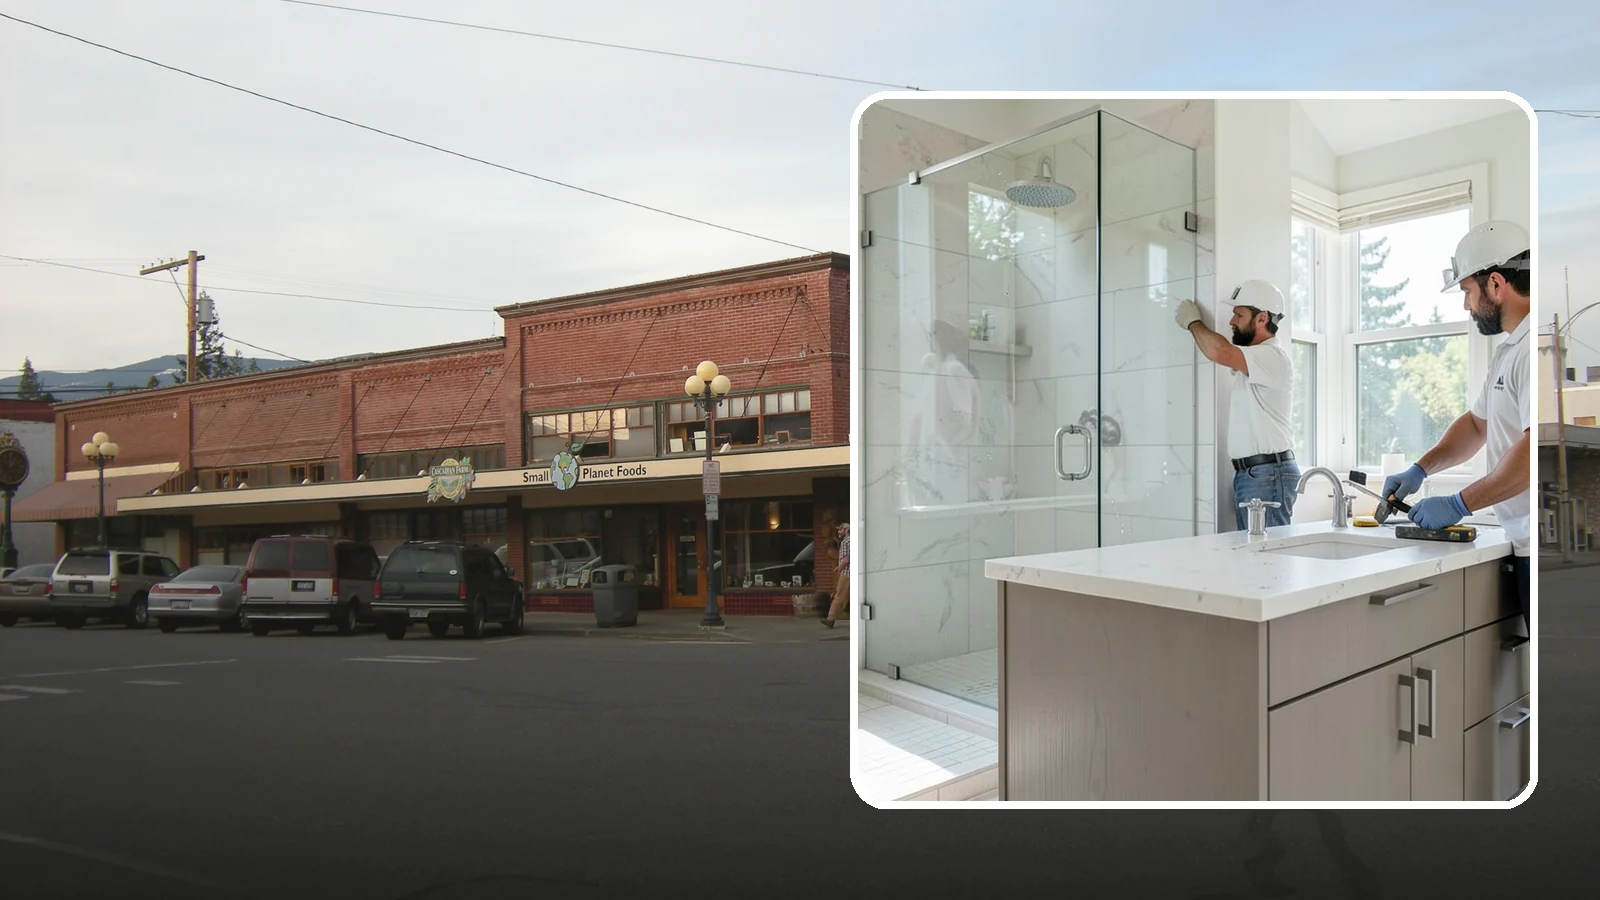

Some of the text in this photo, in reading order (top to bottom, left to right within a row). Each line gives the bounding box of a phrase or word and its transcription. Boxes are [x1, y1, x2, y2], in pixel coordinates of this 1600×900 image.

[523, 464, 647, 483] Small Planet Foods
